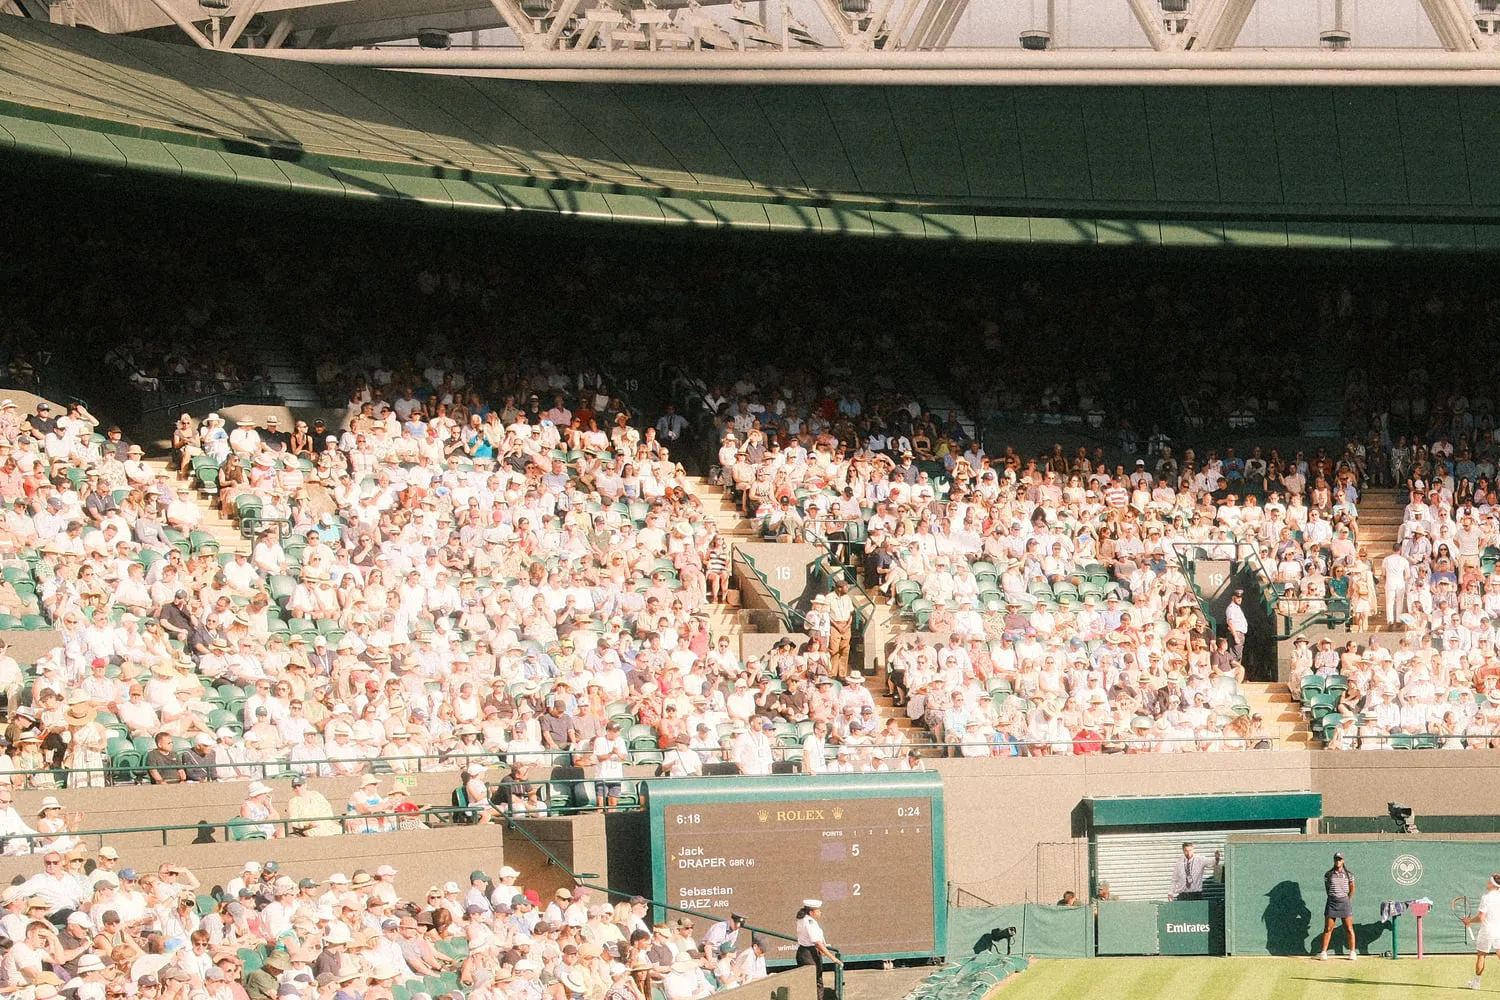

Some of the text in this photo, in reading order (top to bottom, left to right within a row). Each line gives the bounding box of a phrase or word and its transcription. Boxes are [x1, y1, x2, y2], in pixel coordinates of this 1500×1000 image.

[625, 379, 639, 391] 19
[776, 566, 791, 580] 16
[777, 809, 825, 821] ROLEX
[897, 806, 920, 817] 0:24
[676, 813, 701, 825] 6:18
[678, 846, 704, 857] Jack
[851, 844, 860, 856] 5
[679, 857, 726, 869] DRAPER
[729, 859, 745, 867] GBR
[679, 886, 733, 897] Sebastian
[852, 883, 861, 896] 2
[680, 899, 729, 910] BAEZ ARG
[1166, 922, 1210, 933] Emirates
